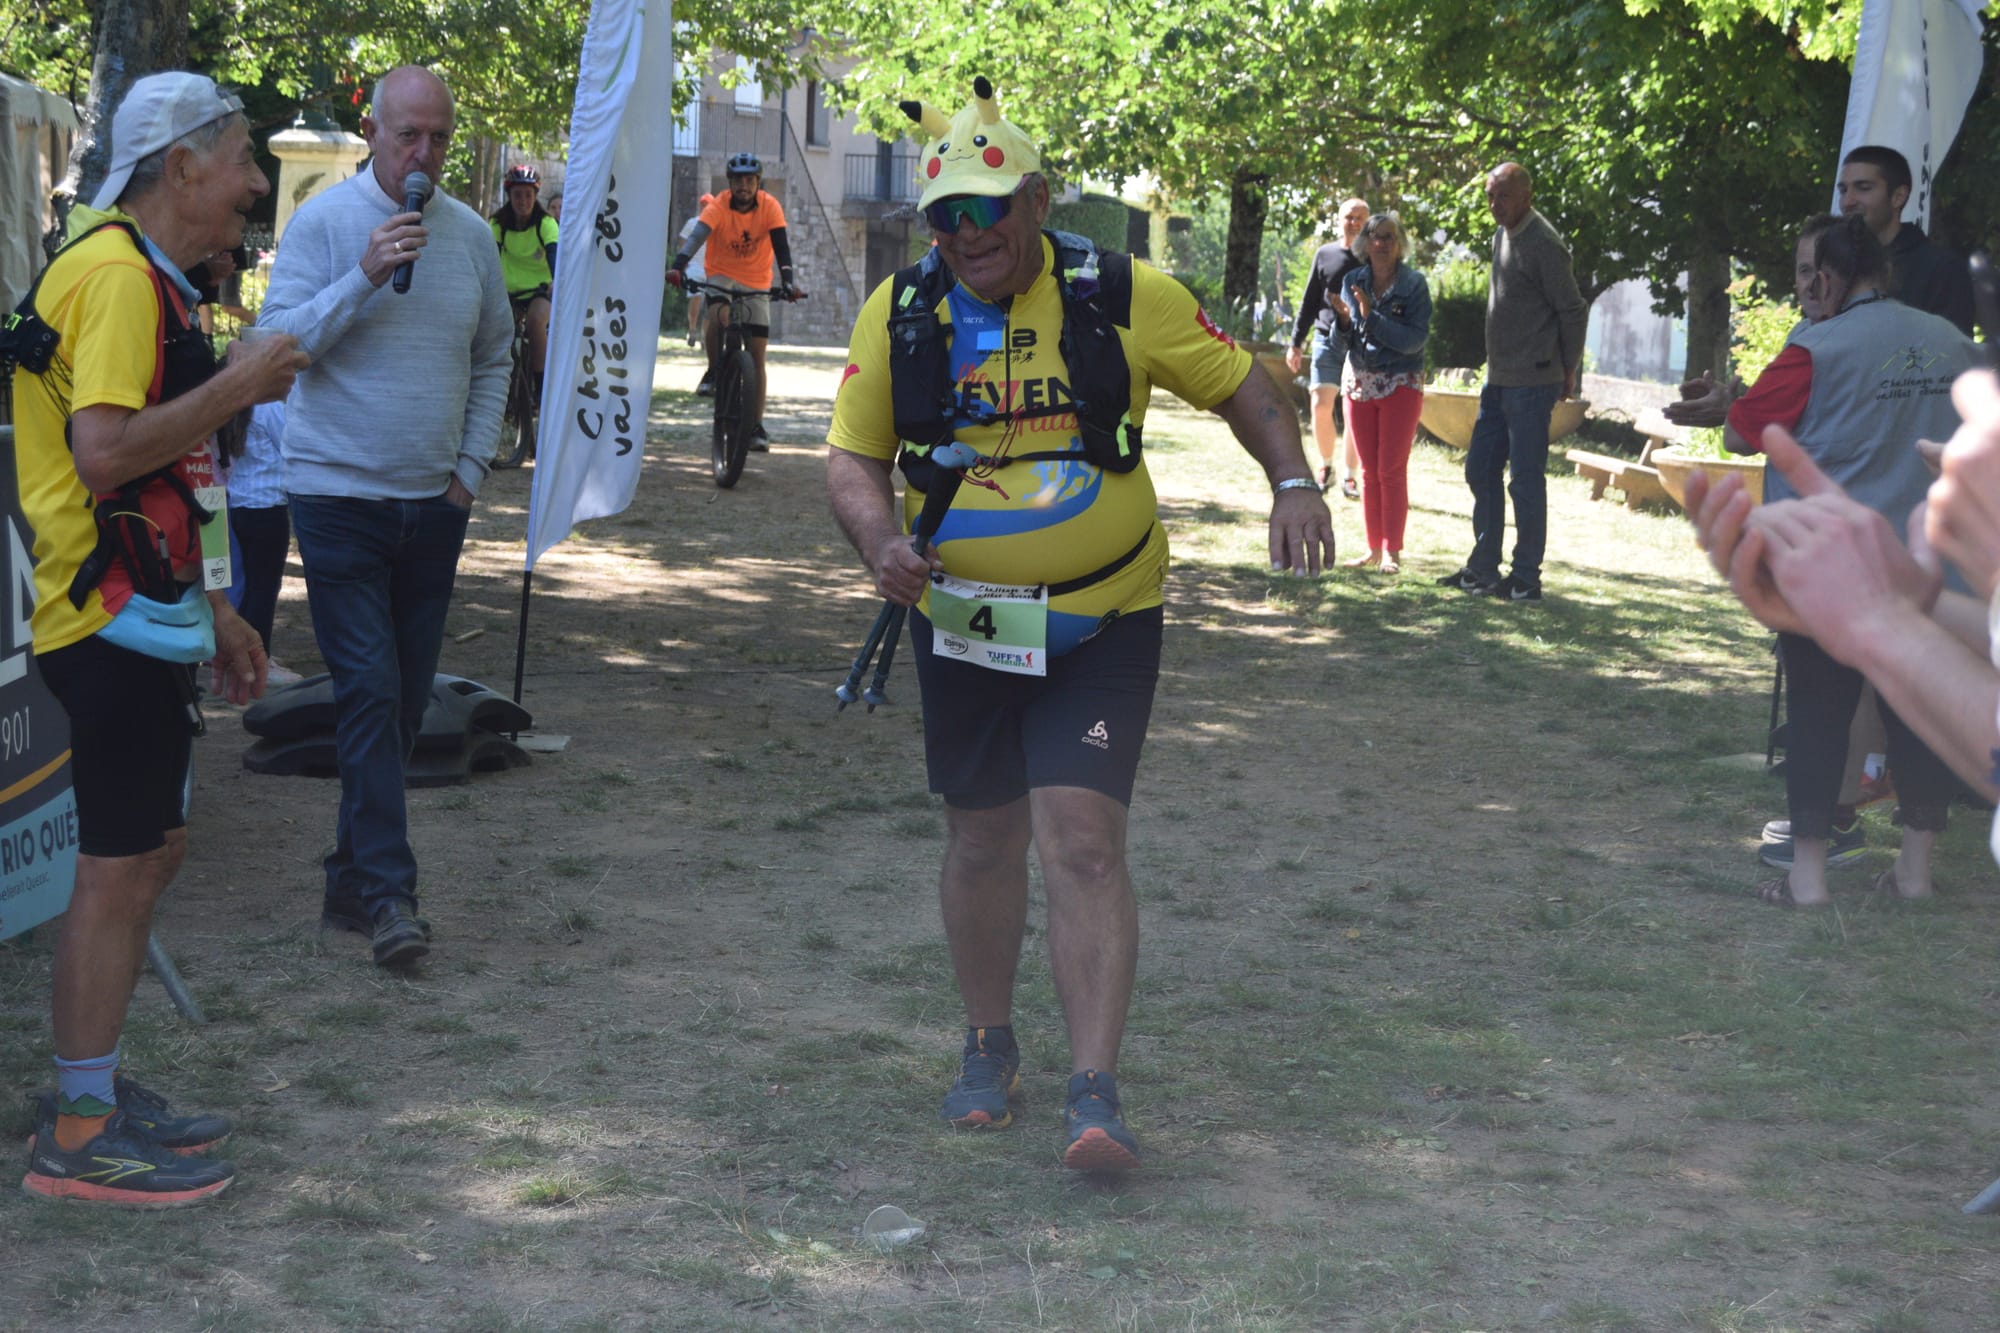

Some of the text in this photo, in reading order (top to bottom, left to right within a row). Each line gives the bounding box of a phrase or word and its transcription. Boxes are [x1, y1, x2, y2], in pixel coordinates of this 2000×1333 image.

[600, 296, 633, 456] vallées
[958, 362, 989, 383] the
[968, 604, 998, 640] 4
[986, 650, 1022, 663] TUFF'S
